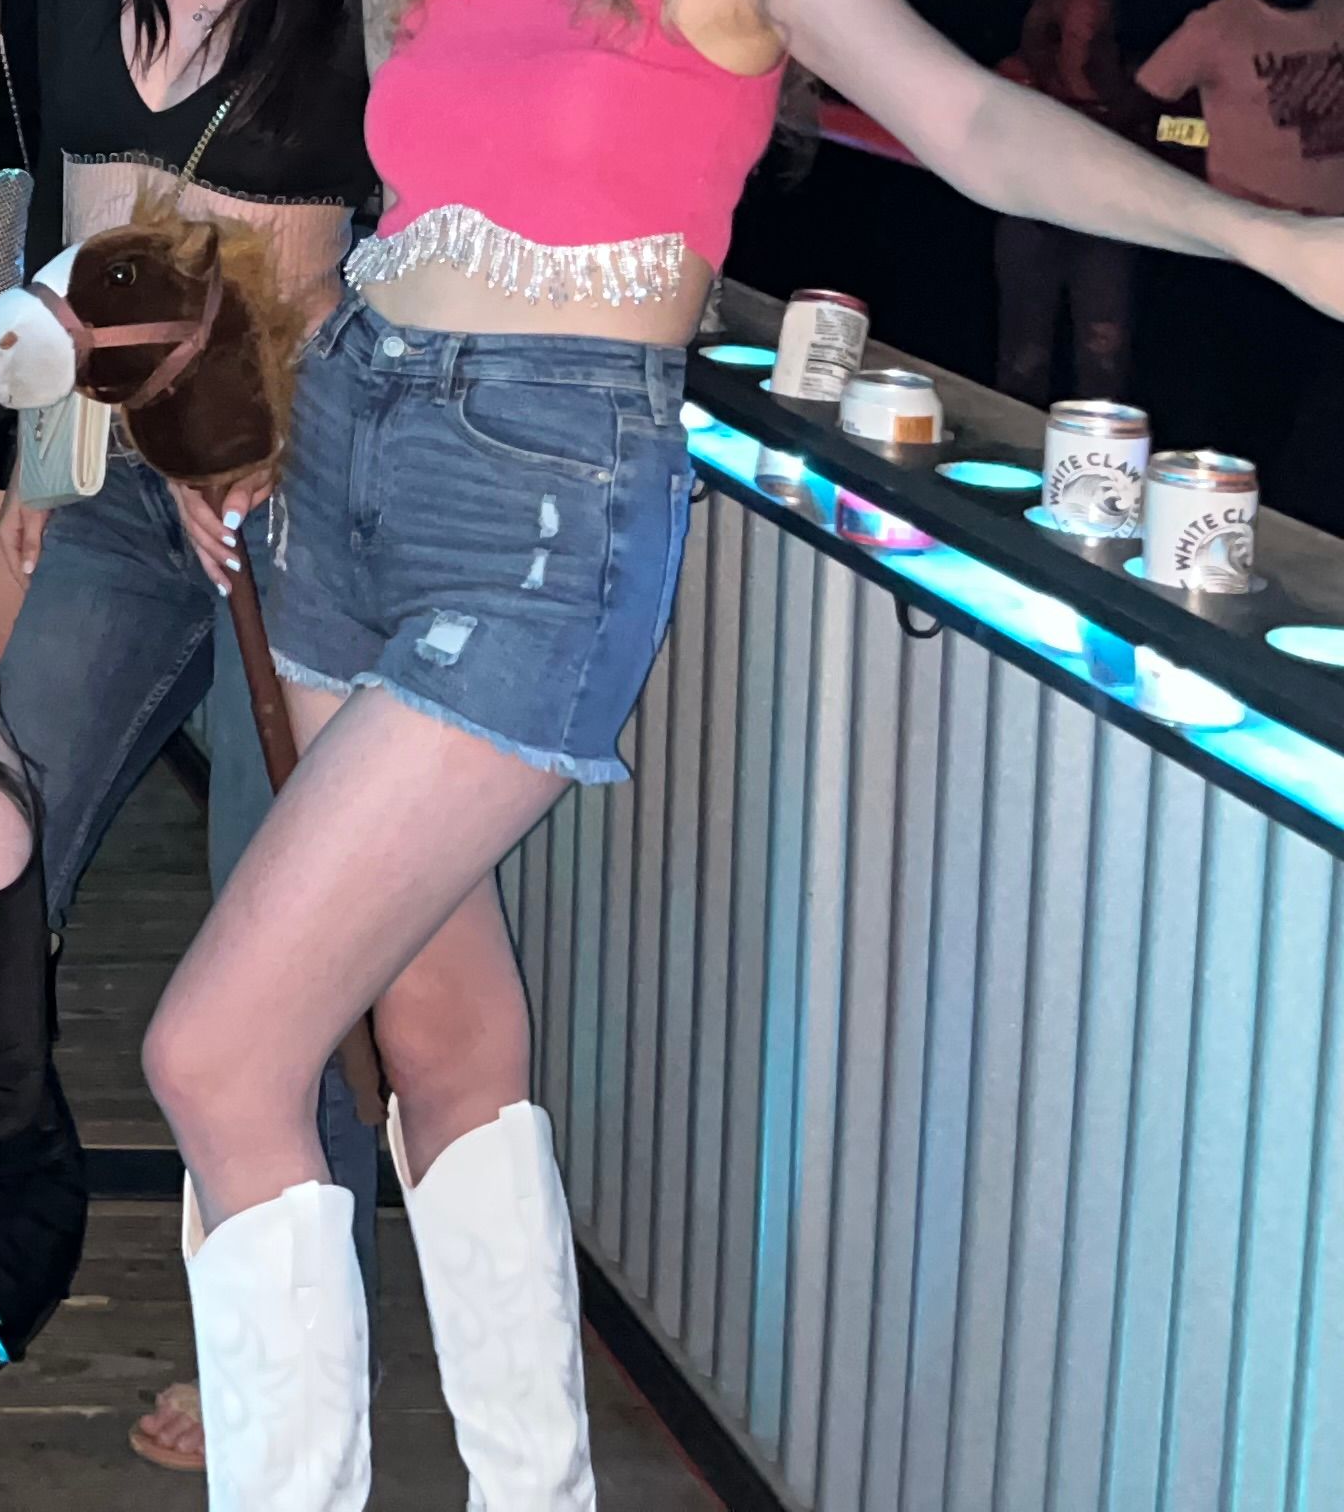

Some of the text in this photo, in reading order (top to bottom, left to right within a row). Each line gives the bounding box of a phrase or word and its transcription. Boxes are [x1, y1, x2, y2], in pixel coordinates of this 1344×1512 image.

[1049, 452, 1141, 505] WHITE CLAW
[1174, 513, 1219, 571] WHITE
